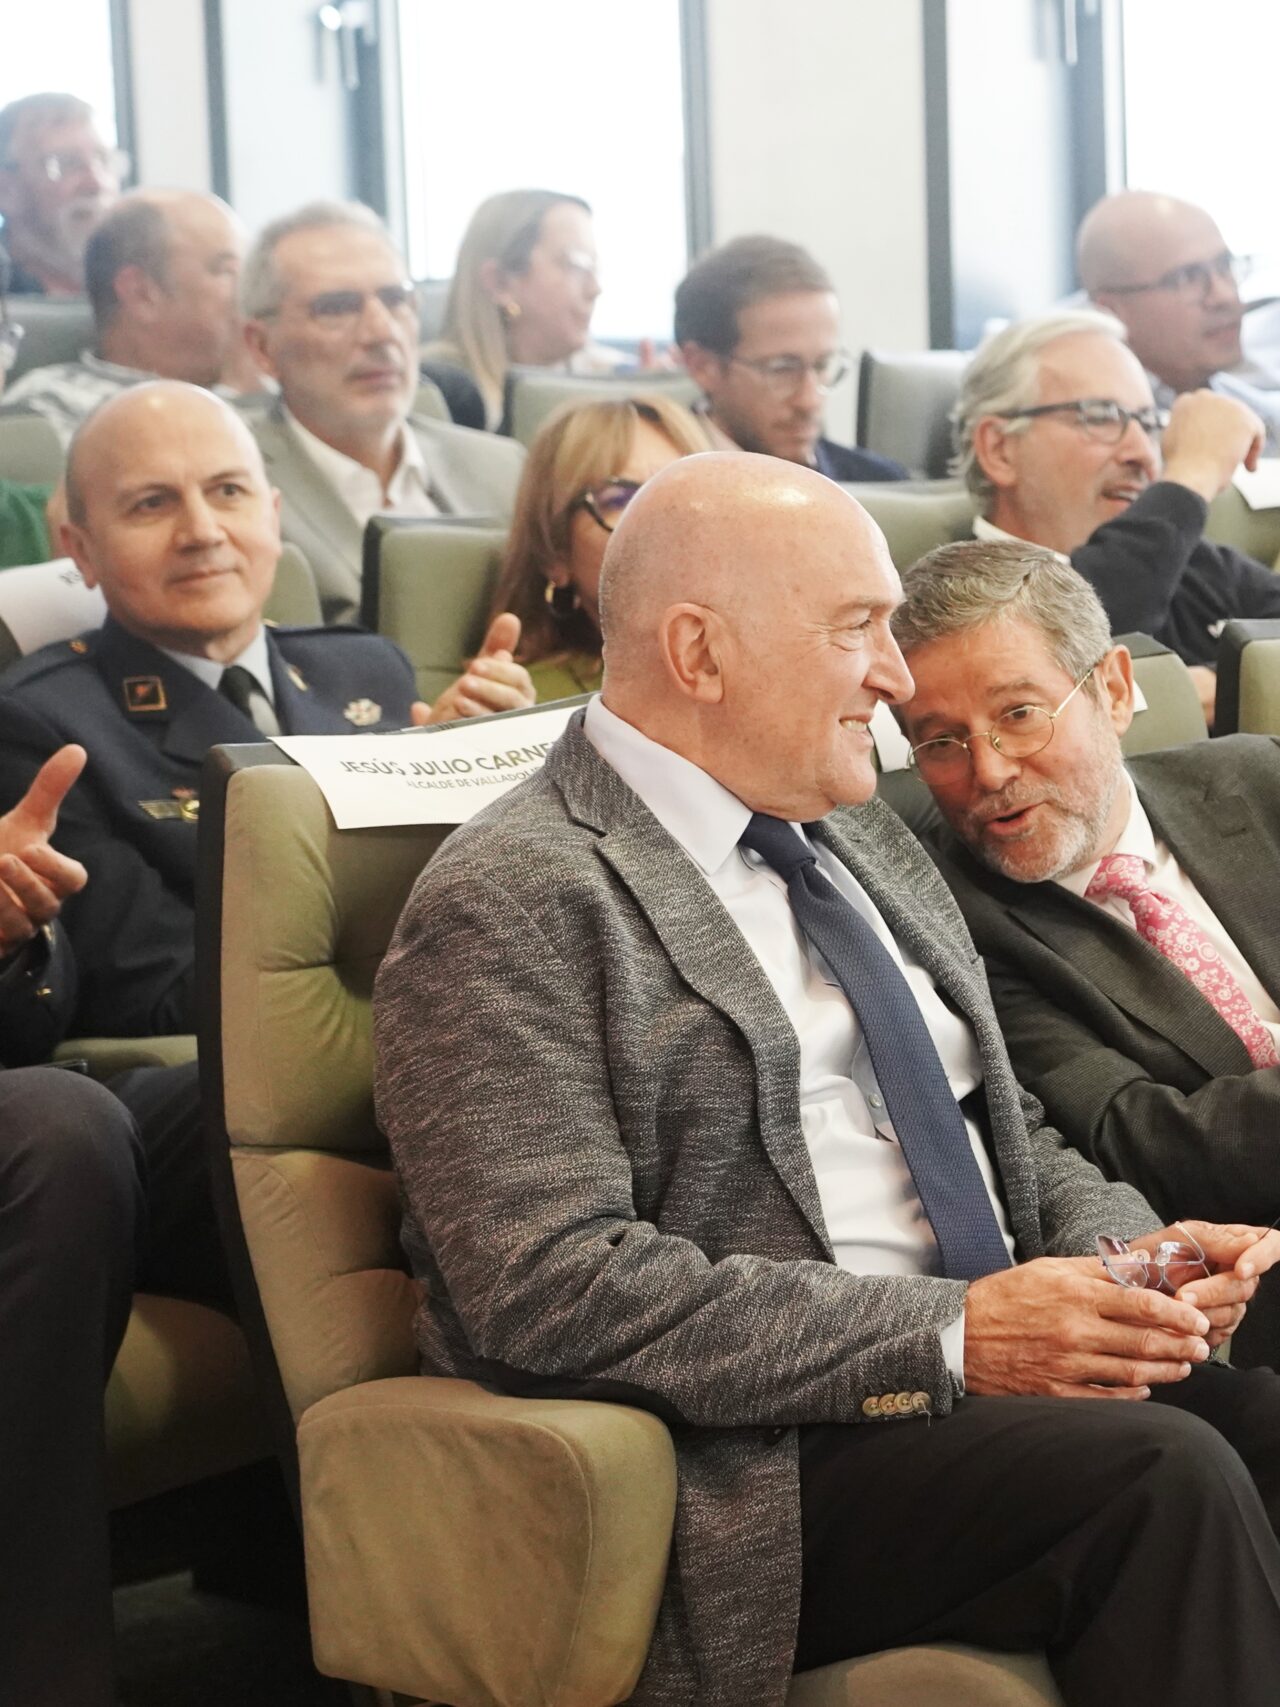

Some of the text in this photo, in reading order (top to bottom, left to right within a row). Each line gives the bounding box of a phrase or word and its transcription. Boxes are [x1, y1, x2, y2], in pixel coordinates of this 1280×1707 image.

[339, 757, 406, 776] JESÚS
[409, 758, 473, 776] JULIO
[456, 778, 473, 787] DE
